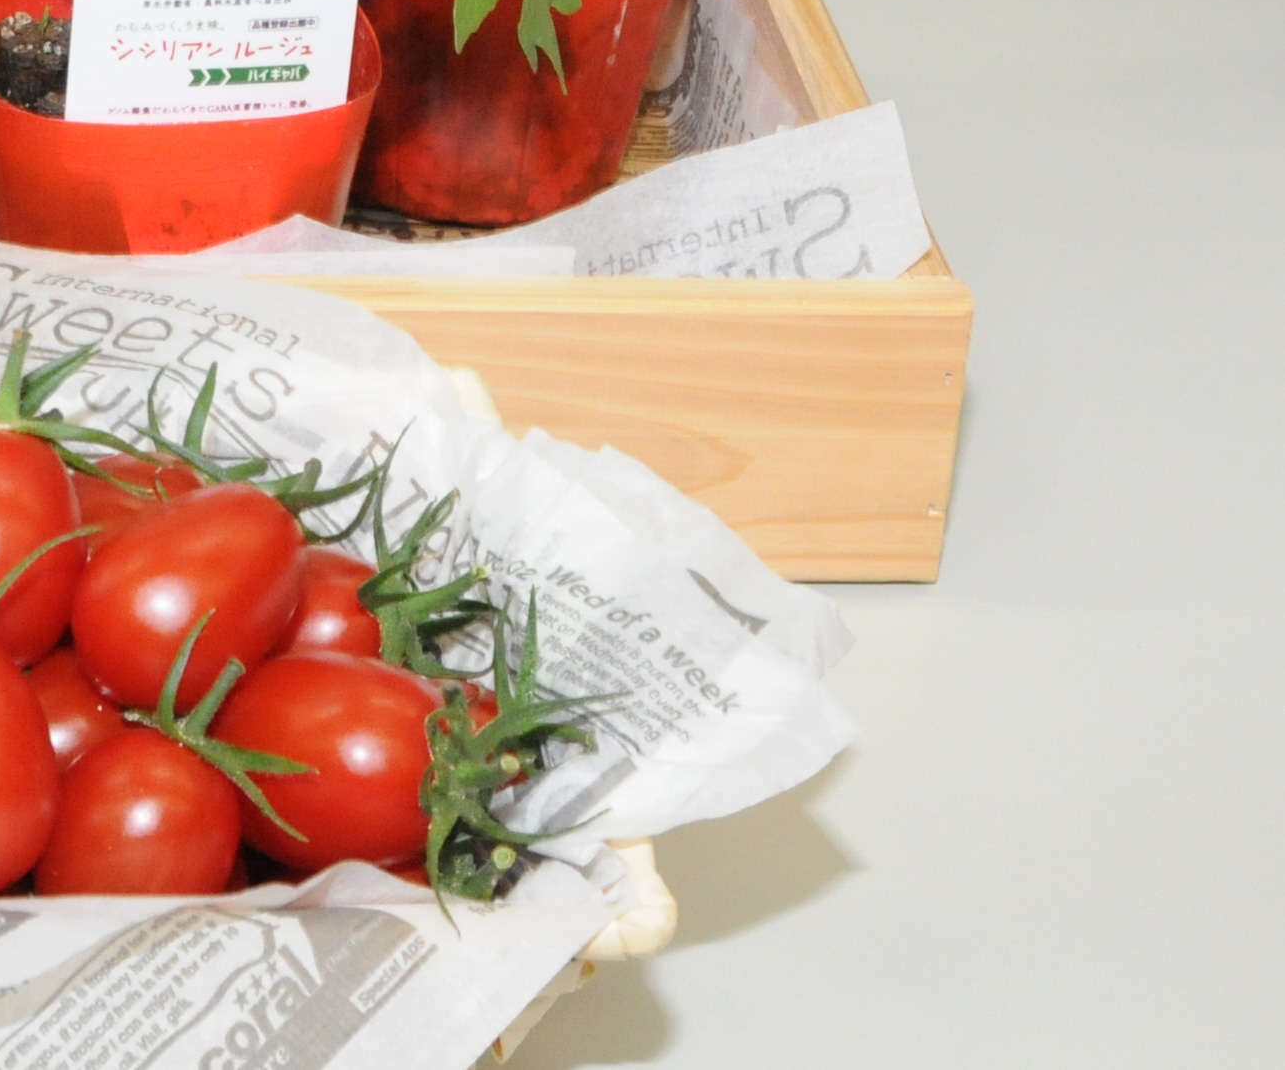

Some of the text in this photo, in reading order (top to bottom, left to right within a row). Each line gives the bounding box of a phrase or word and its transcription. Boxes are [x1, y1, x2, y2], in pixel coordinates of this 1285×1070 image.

[110, 35, 314, 61] シシリアン ルージュ
[246, 66, 302, 81] ハイギャバ
[31, 271, 302, 361] International
[545, 565, 742, 716] Wed of a week
[196, 942, 323, 1070] coral
[356, 956, 403, 1008] Special
